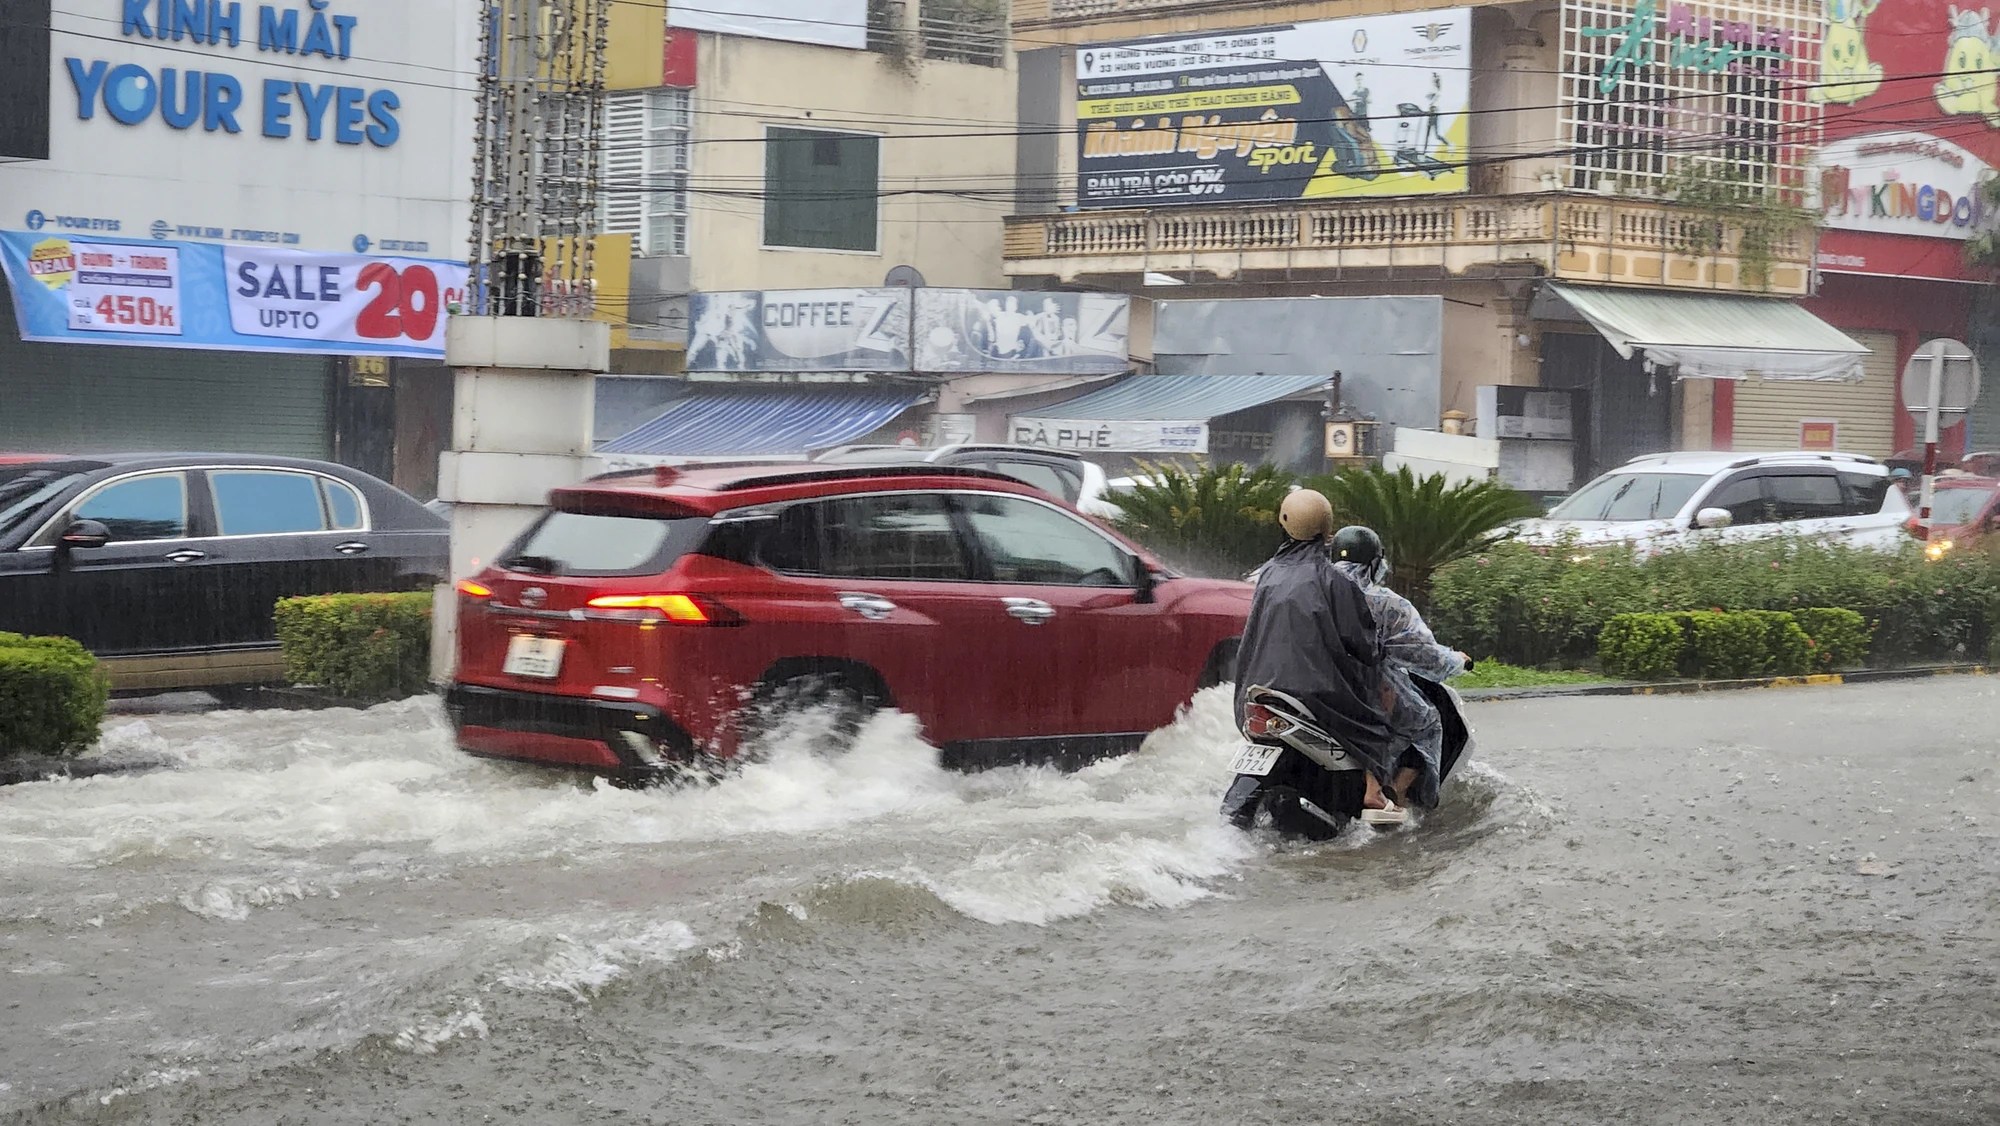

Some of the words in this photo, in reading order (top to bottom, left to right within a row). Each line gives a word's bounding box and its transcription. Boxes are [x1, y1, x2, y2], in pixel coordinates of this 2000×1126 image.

[64, 57, 243, 134] YOUR
[262, 78, 401, 148] EYES
[1248, 141, 1318, 175] sport
[30, 256, 72, 275] DEAL
[236, 260, 341, 302] SALE
[763, 301, 855, 328] COFFEE
[1015, 422, 1050, 446] CÀ
[1057, 424, 1113, 448] PHÊ
